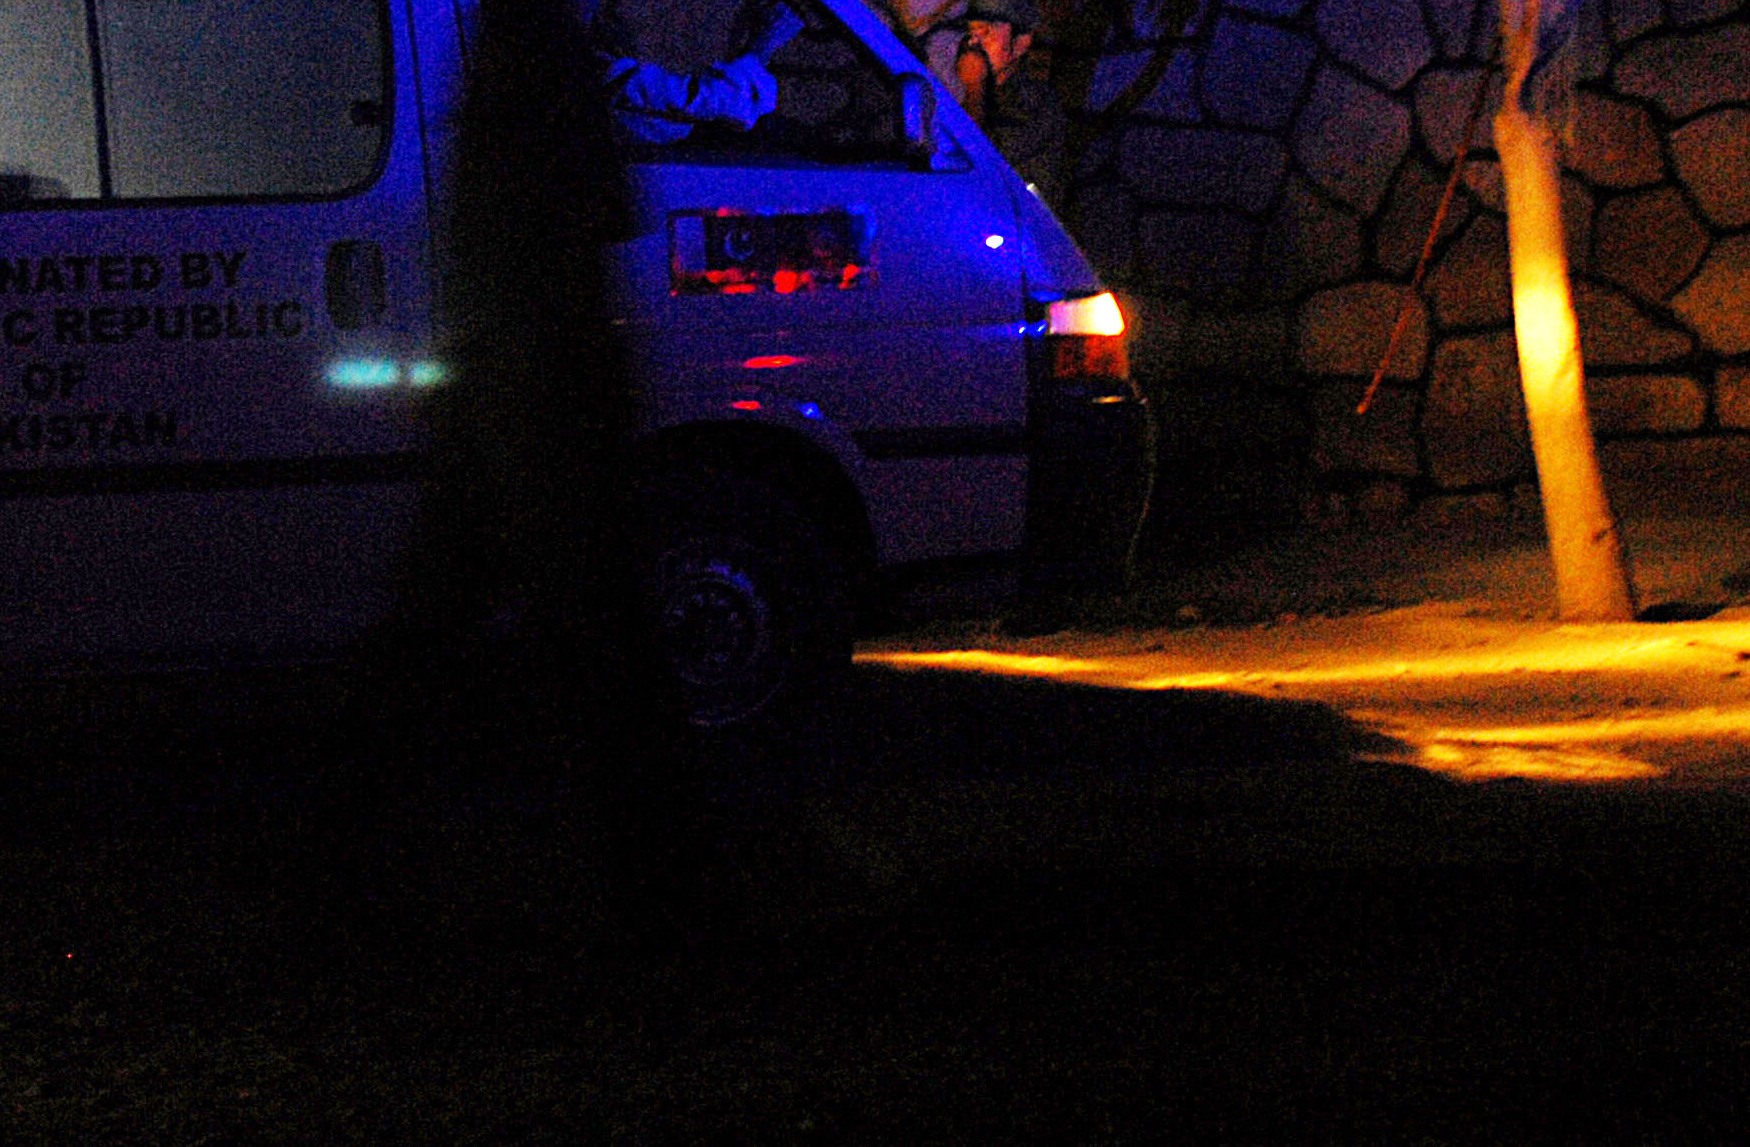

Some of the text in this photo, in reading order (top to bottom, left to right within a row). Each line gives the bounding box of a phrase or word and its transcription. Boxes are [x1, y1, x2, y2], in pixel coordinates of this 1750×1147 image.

[182, 252, 245, 287] BY
[54, 301, 302, 343] REPUBLIC
[24, 362, 87, 400] OF
